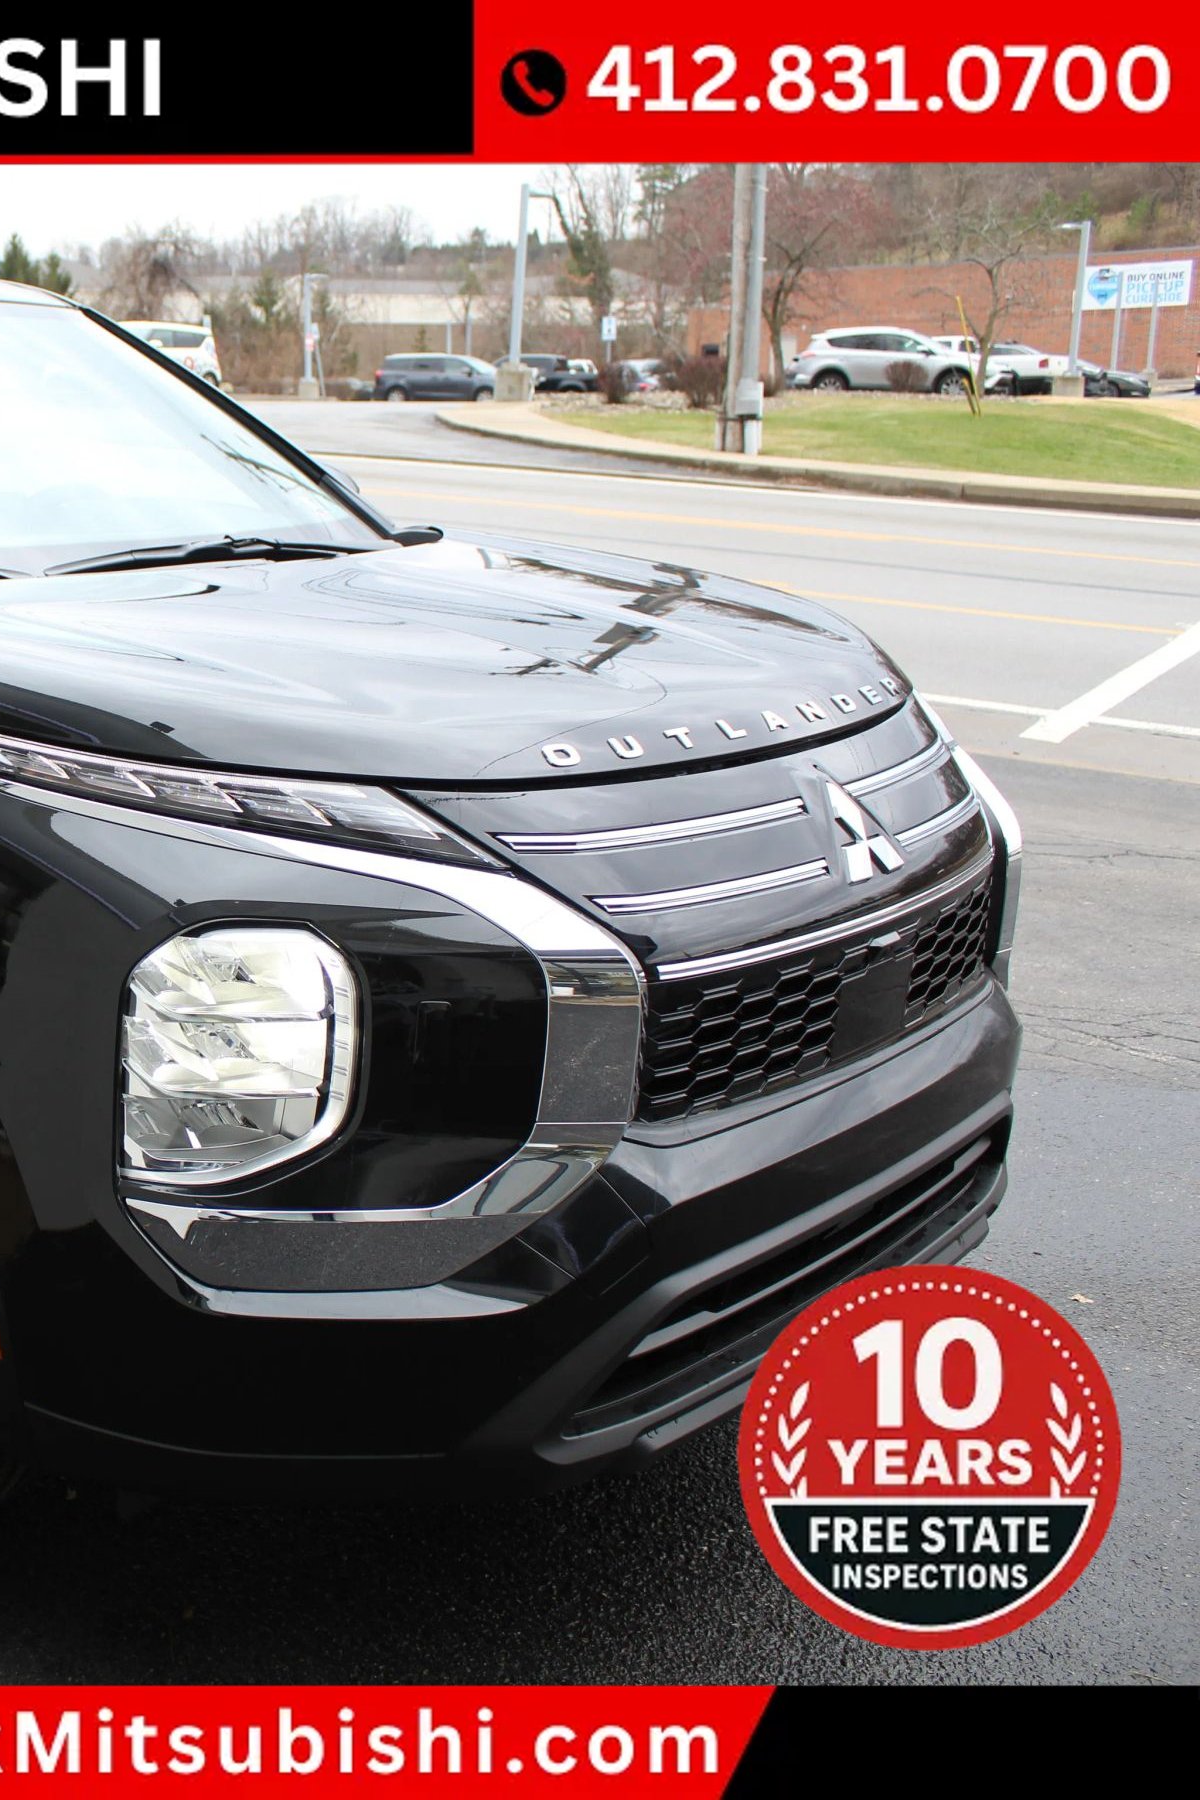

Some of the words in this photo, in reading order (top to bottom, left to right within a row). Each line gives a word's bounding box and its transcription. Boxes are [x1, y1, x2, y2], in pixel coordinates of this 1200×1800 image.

[1127, 273, 1147, 282] BUY
[1149, 271, 1184, 281] ONLINE
[541, 677, 901, 767] OUTLANDER
